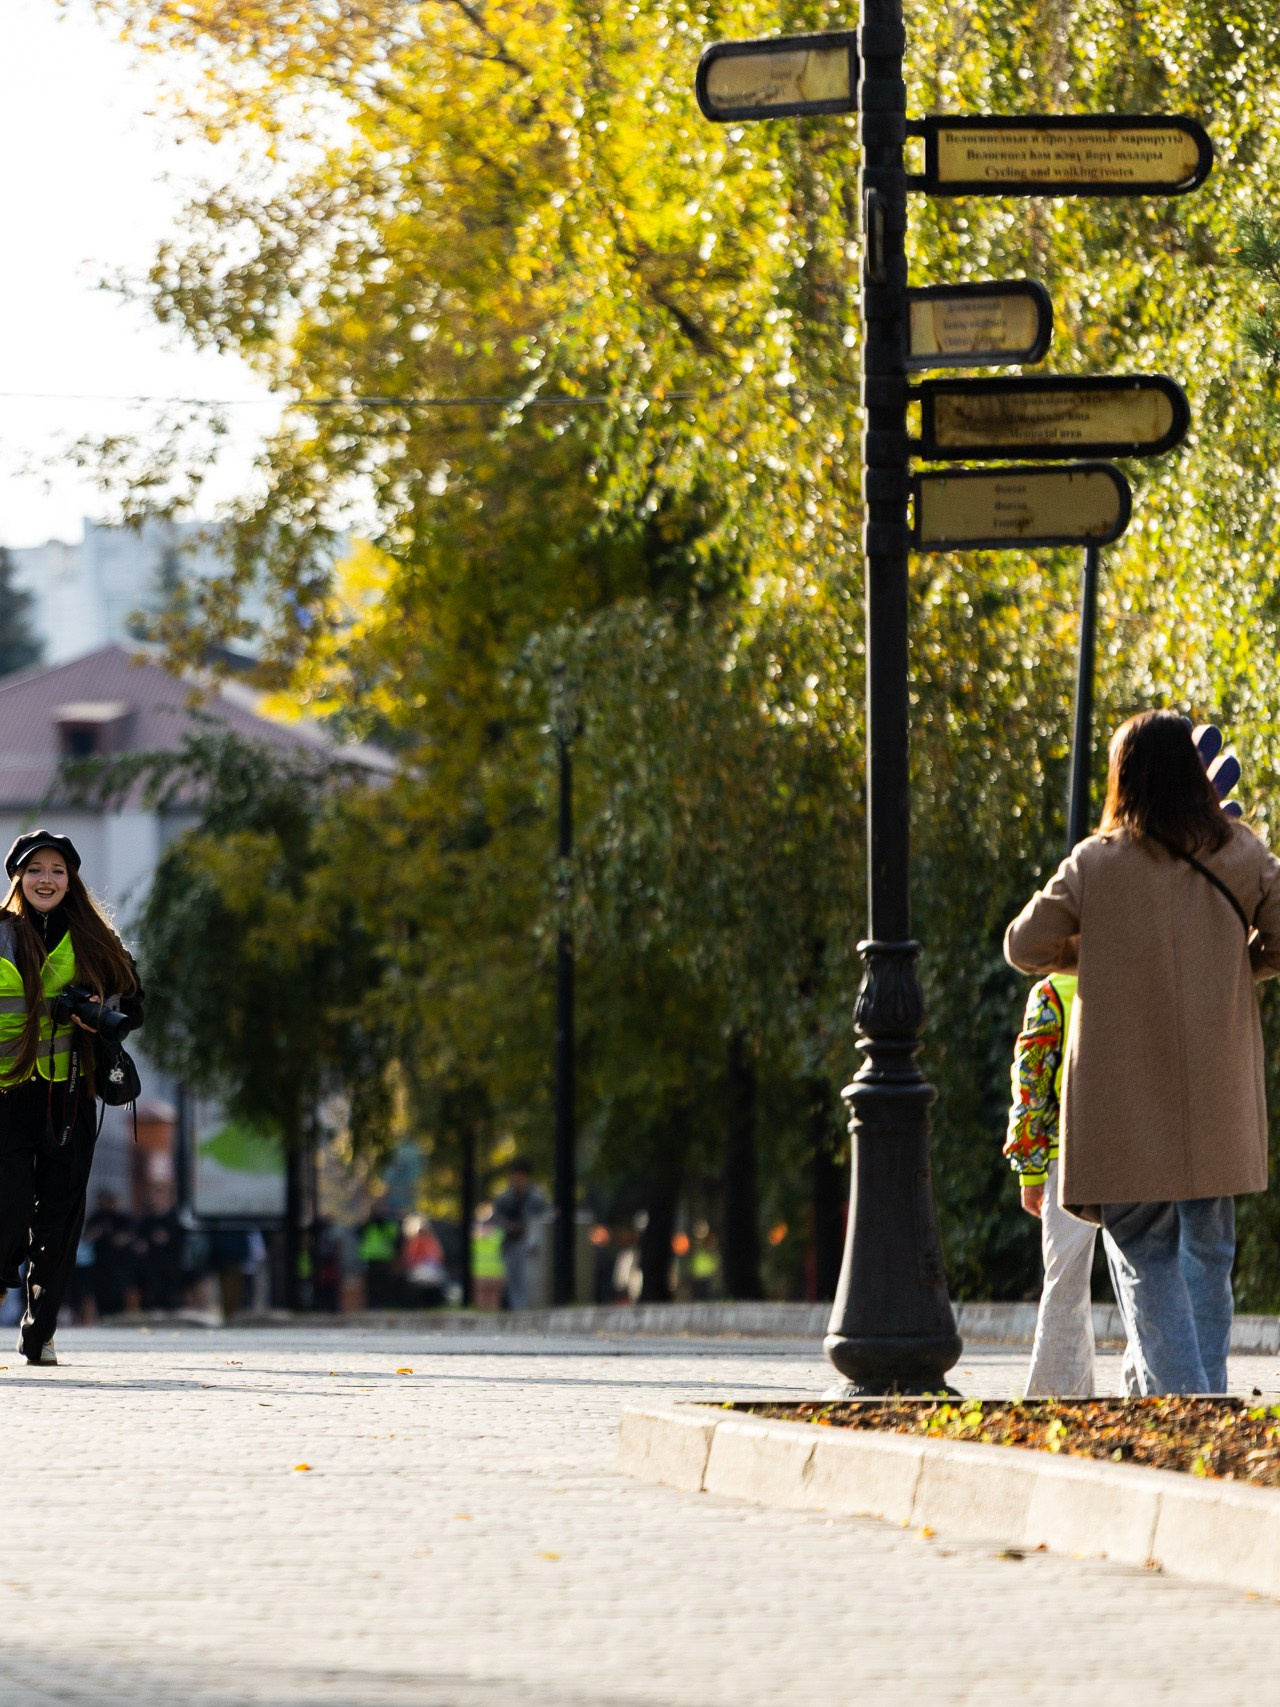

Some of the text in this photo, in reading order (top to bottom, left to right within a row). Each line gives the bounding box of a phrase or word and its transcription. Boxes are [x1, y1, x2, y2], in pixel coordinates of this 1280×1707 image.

[984, 166, 1027, 178] Cycling
[1030, 166, 1051, 176] and
[1053, 166, 1097, 178] walking
[69, 1066, 78, 1094] DIGITAL
